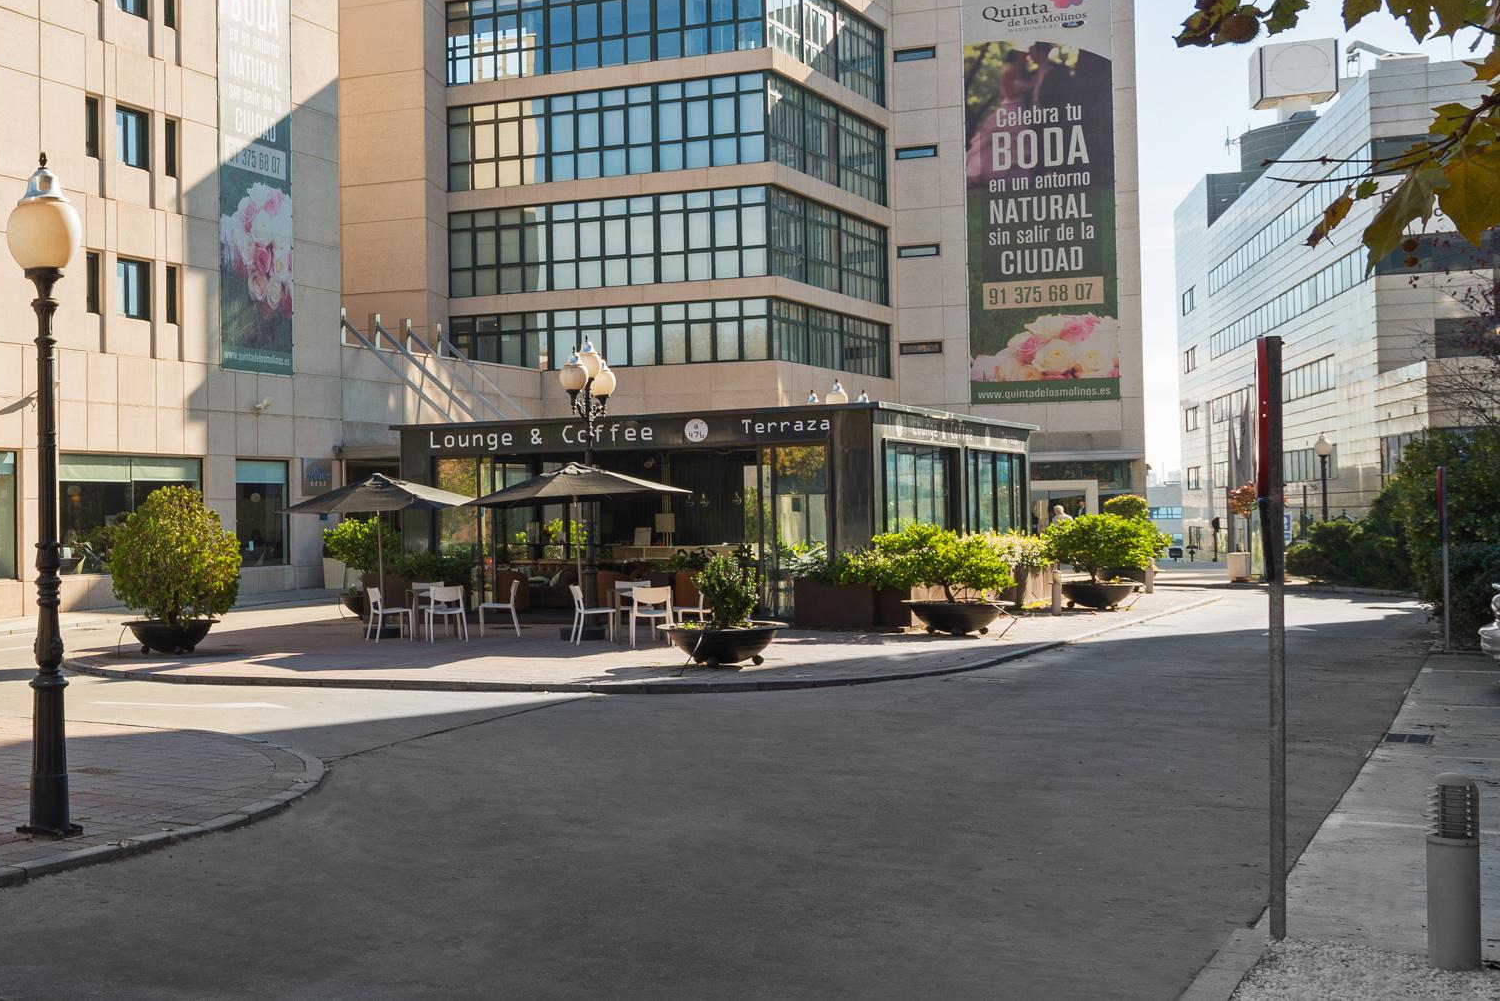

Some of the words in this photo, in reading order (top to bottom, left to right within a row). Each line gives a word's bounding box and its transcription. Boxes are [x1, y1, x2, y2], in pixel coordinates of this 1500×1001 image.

[982, 2, 1049, 23] Quinta
[1007, 18, 1020, 27] de
[1023, 16, 1039, 25] los
[1041, 12, 1087, 24] Molinos
[229, 48, 280, 91] NATURAL
[235, 106, 277, 143] CIUDAD
[995, 104, 1059, 128] Celebra
[1065, 102, 1082, 122] tu
[242, 147, 257, 168] 375
[259, 152, 269, 171] 68
[271, 156, 281, 175] 07
[991, 124, 1090, 172] BODA
[989, 179, 1006, 193] en
[1012, 176, 1029, 192] un
[1035, 171, 1091, 190] entorno
[989, 192, 1093, 225] NATURAL
[988, 227, 1011, 246] sin
[1016, 224, 1051, 244] salir
[1056, 223, 1075, 242] de
[1081, 221, 1095, 240] la
[1001, 246, 1084, 276] CIUDAD
[989, 287, 1007, 306] 91
[1014, 285, 1042, 304] 375
[1048, 284, 1069, 302] 68
[1075, 282, 1094, 301] 07
[978, 385, 1112, 401] www.quintadelosmolinos.es
[429, 430, 514, 451] Lounge
[530, 427, 544, 446] &
[561, 422, 654, 444] Coffee
[741, 417, 831, 435] Terraza
